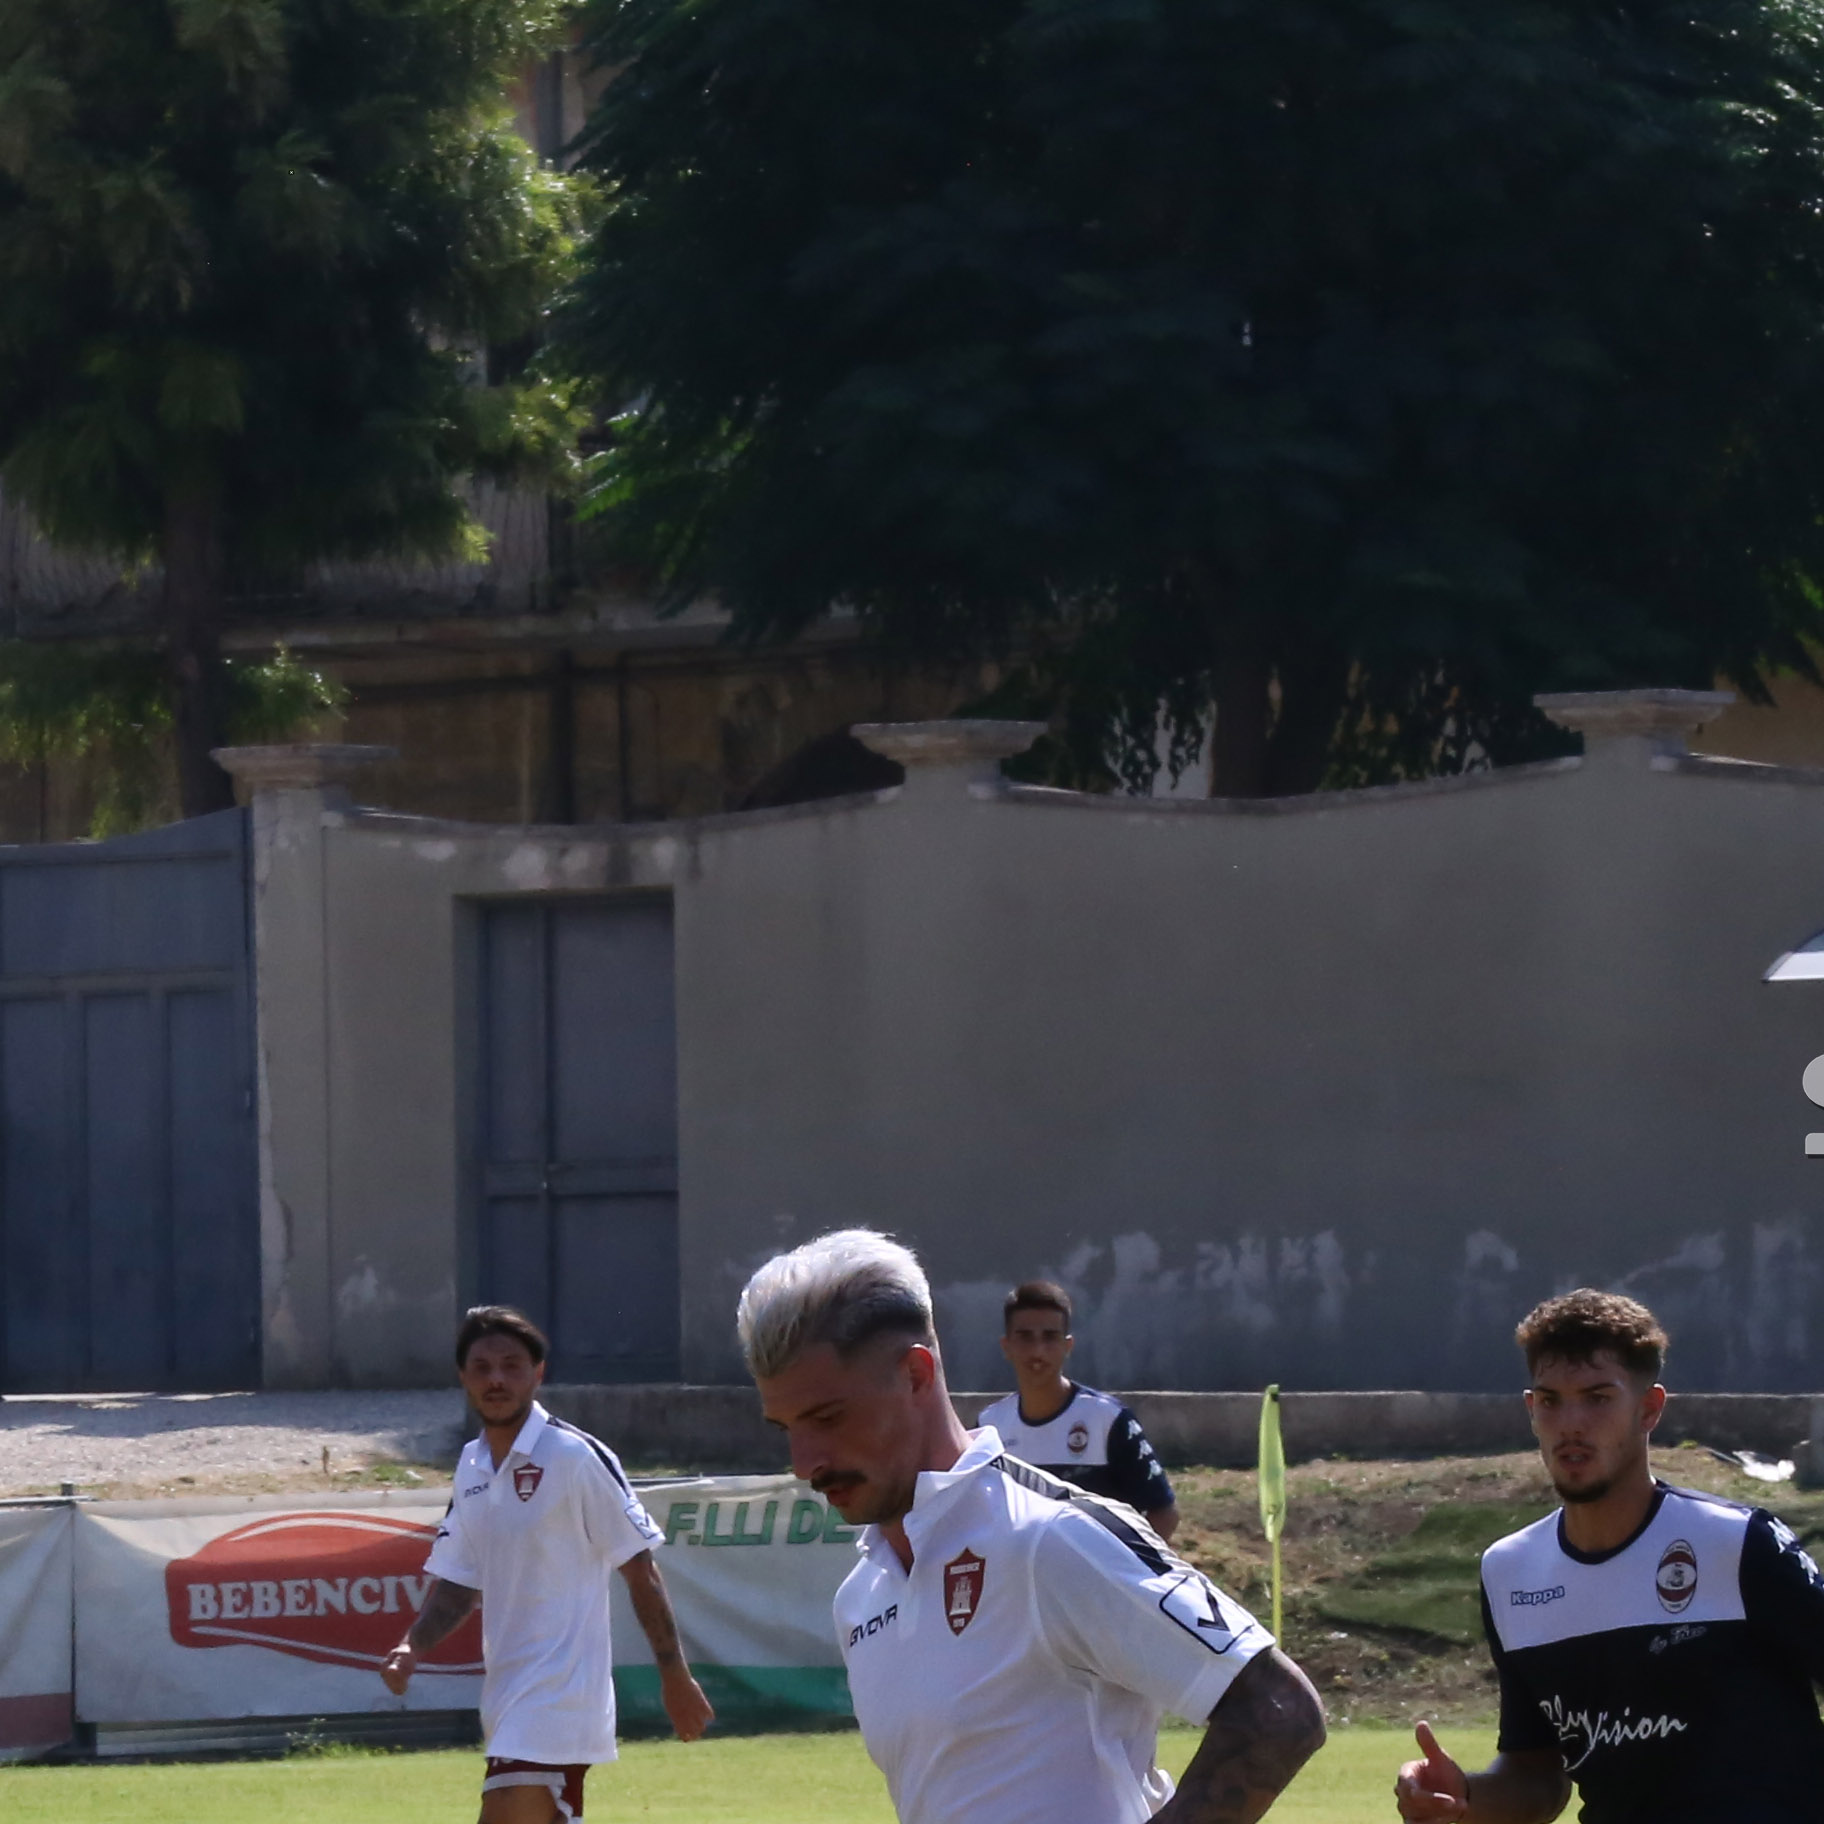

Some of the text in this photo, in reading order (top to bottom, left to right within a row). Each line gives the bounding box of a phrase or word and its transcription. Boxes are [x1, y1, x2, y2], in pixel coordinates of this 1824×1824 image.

[664, 1500, 778, 1546] F.LLI
[187, 1574, 433, 1622] BEBENCIV
[1511, 1585, 1565, 1606] Kappa
